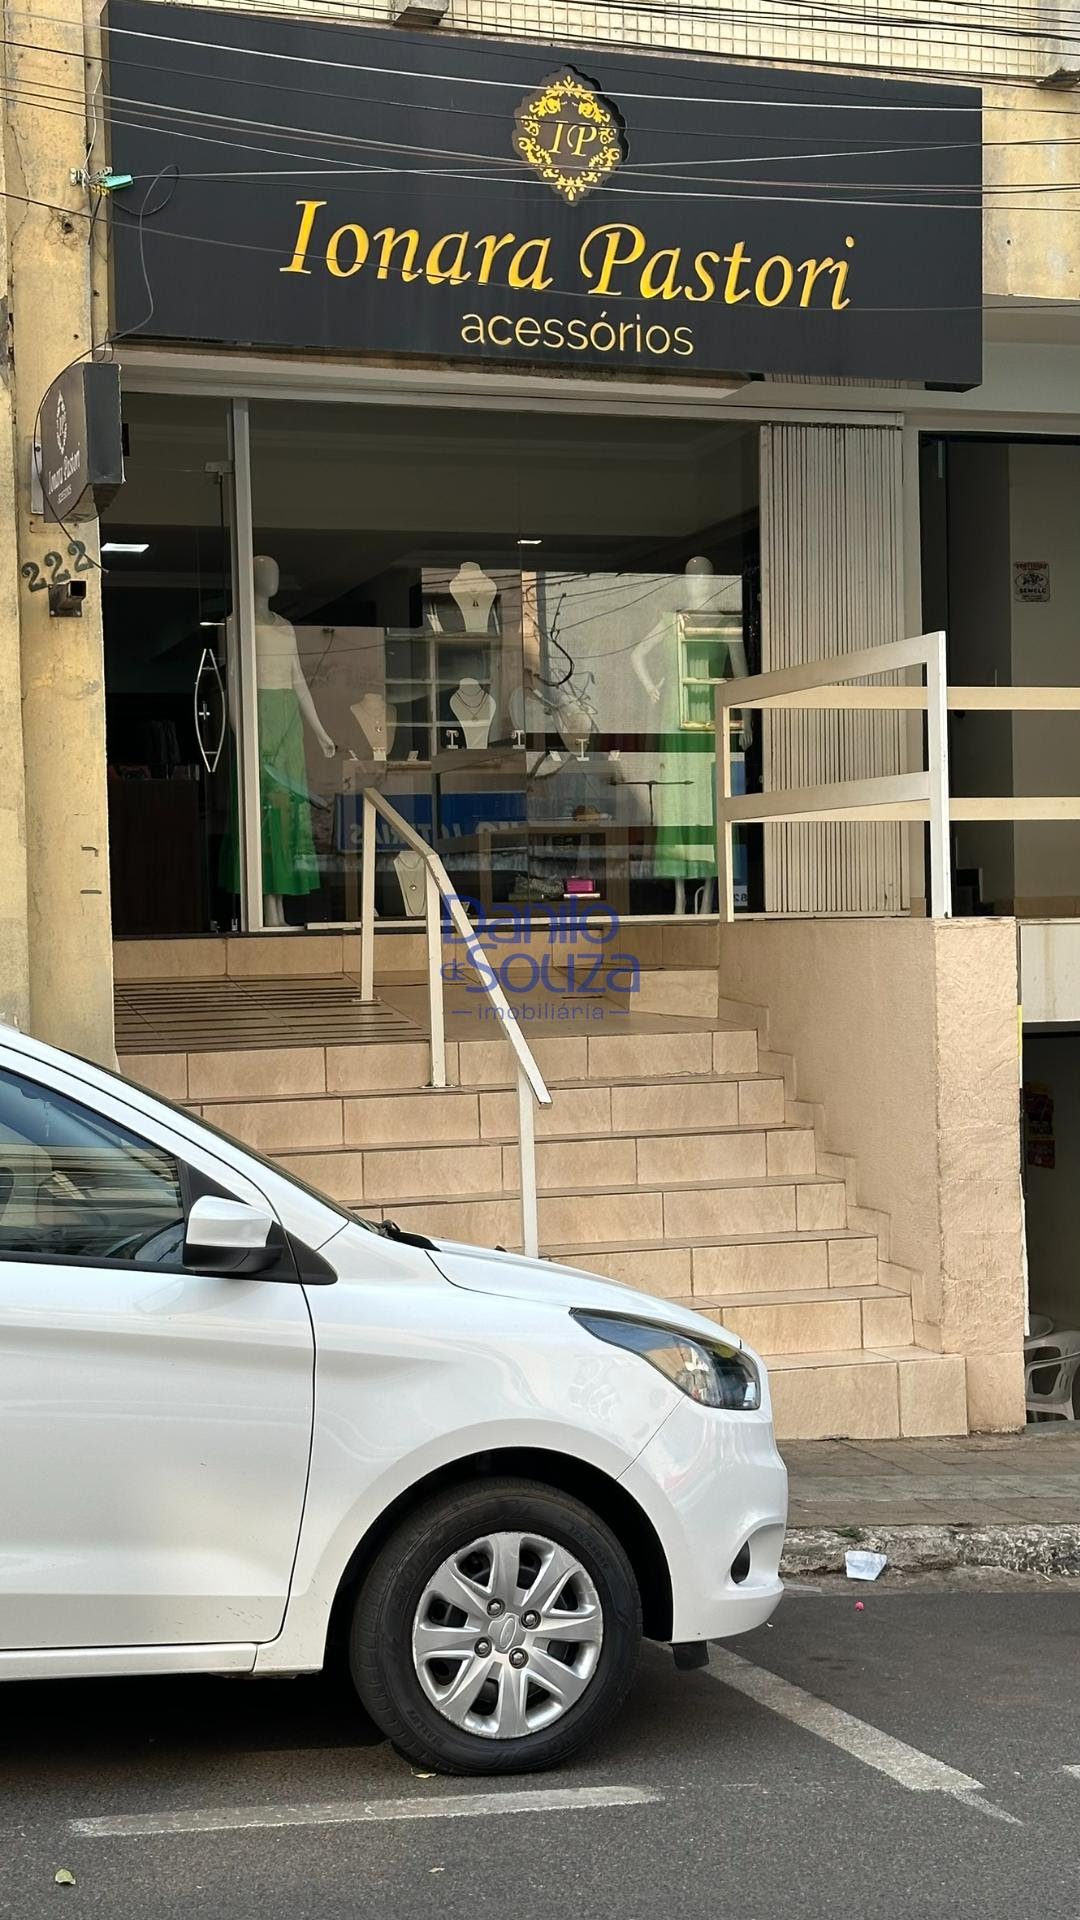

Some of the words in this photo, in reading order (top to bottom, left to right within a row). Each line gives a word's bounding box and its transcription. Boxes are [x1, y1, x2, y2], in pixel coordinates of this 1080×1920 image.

[279, 199, 556, 292] Ionara
[579, 222, 857, 311] Pastori
[460, 311, 695, 357] acessórios
[21, 540, 94, 593] 222
